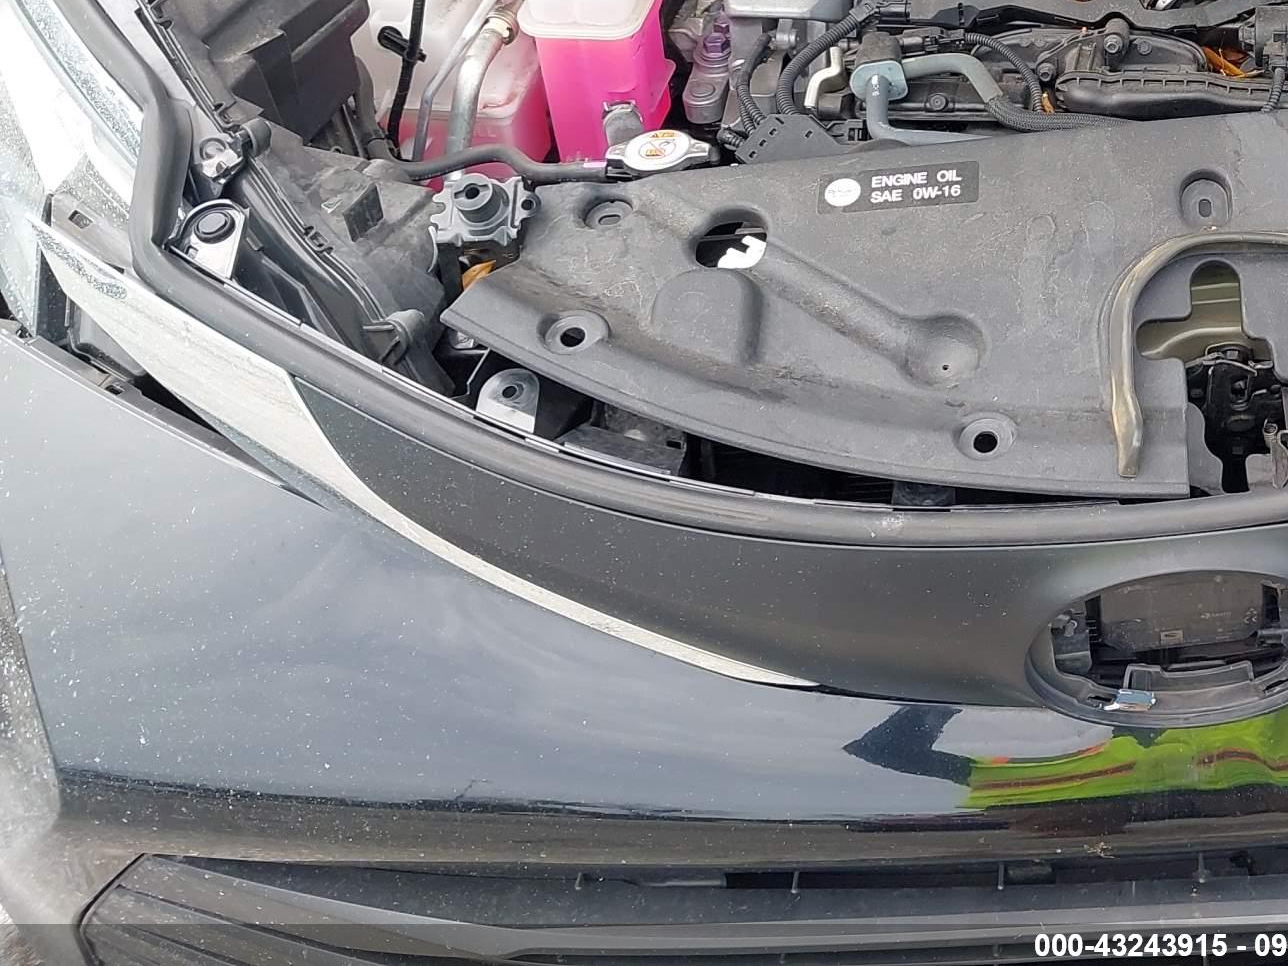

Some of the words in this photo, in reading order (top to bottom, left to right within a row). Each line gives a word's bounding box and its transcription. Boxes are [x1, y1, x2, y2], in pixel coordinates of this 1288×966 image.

[871, 171, 927, 189] ENGINE
[936, 169, 962, 183] OIL
[870, 189, 903, 203] SAE
[912, 184, 961, 201] 0W-16
